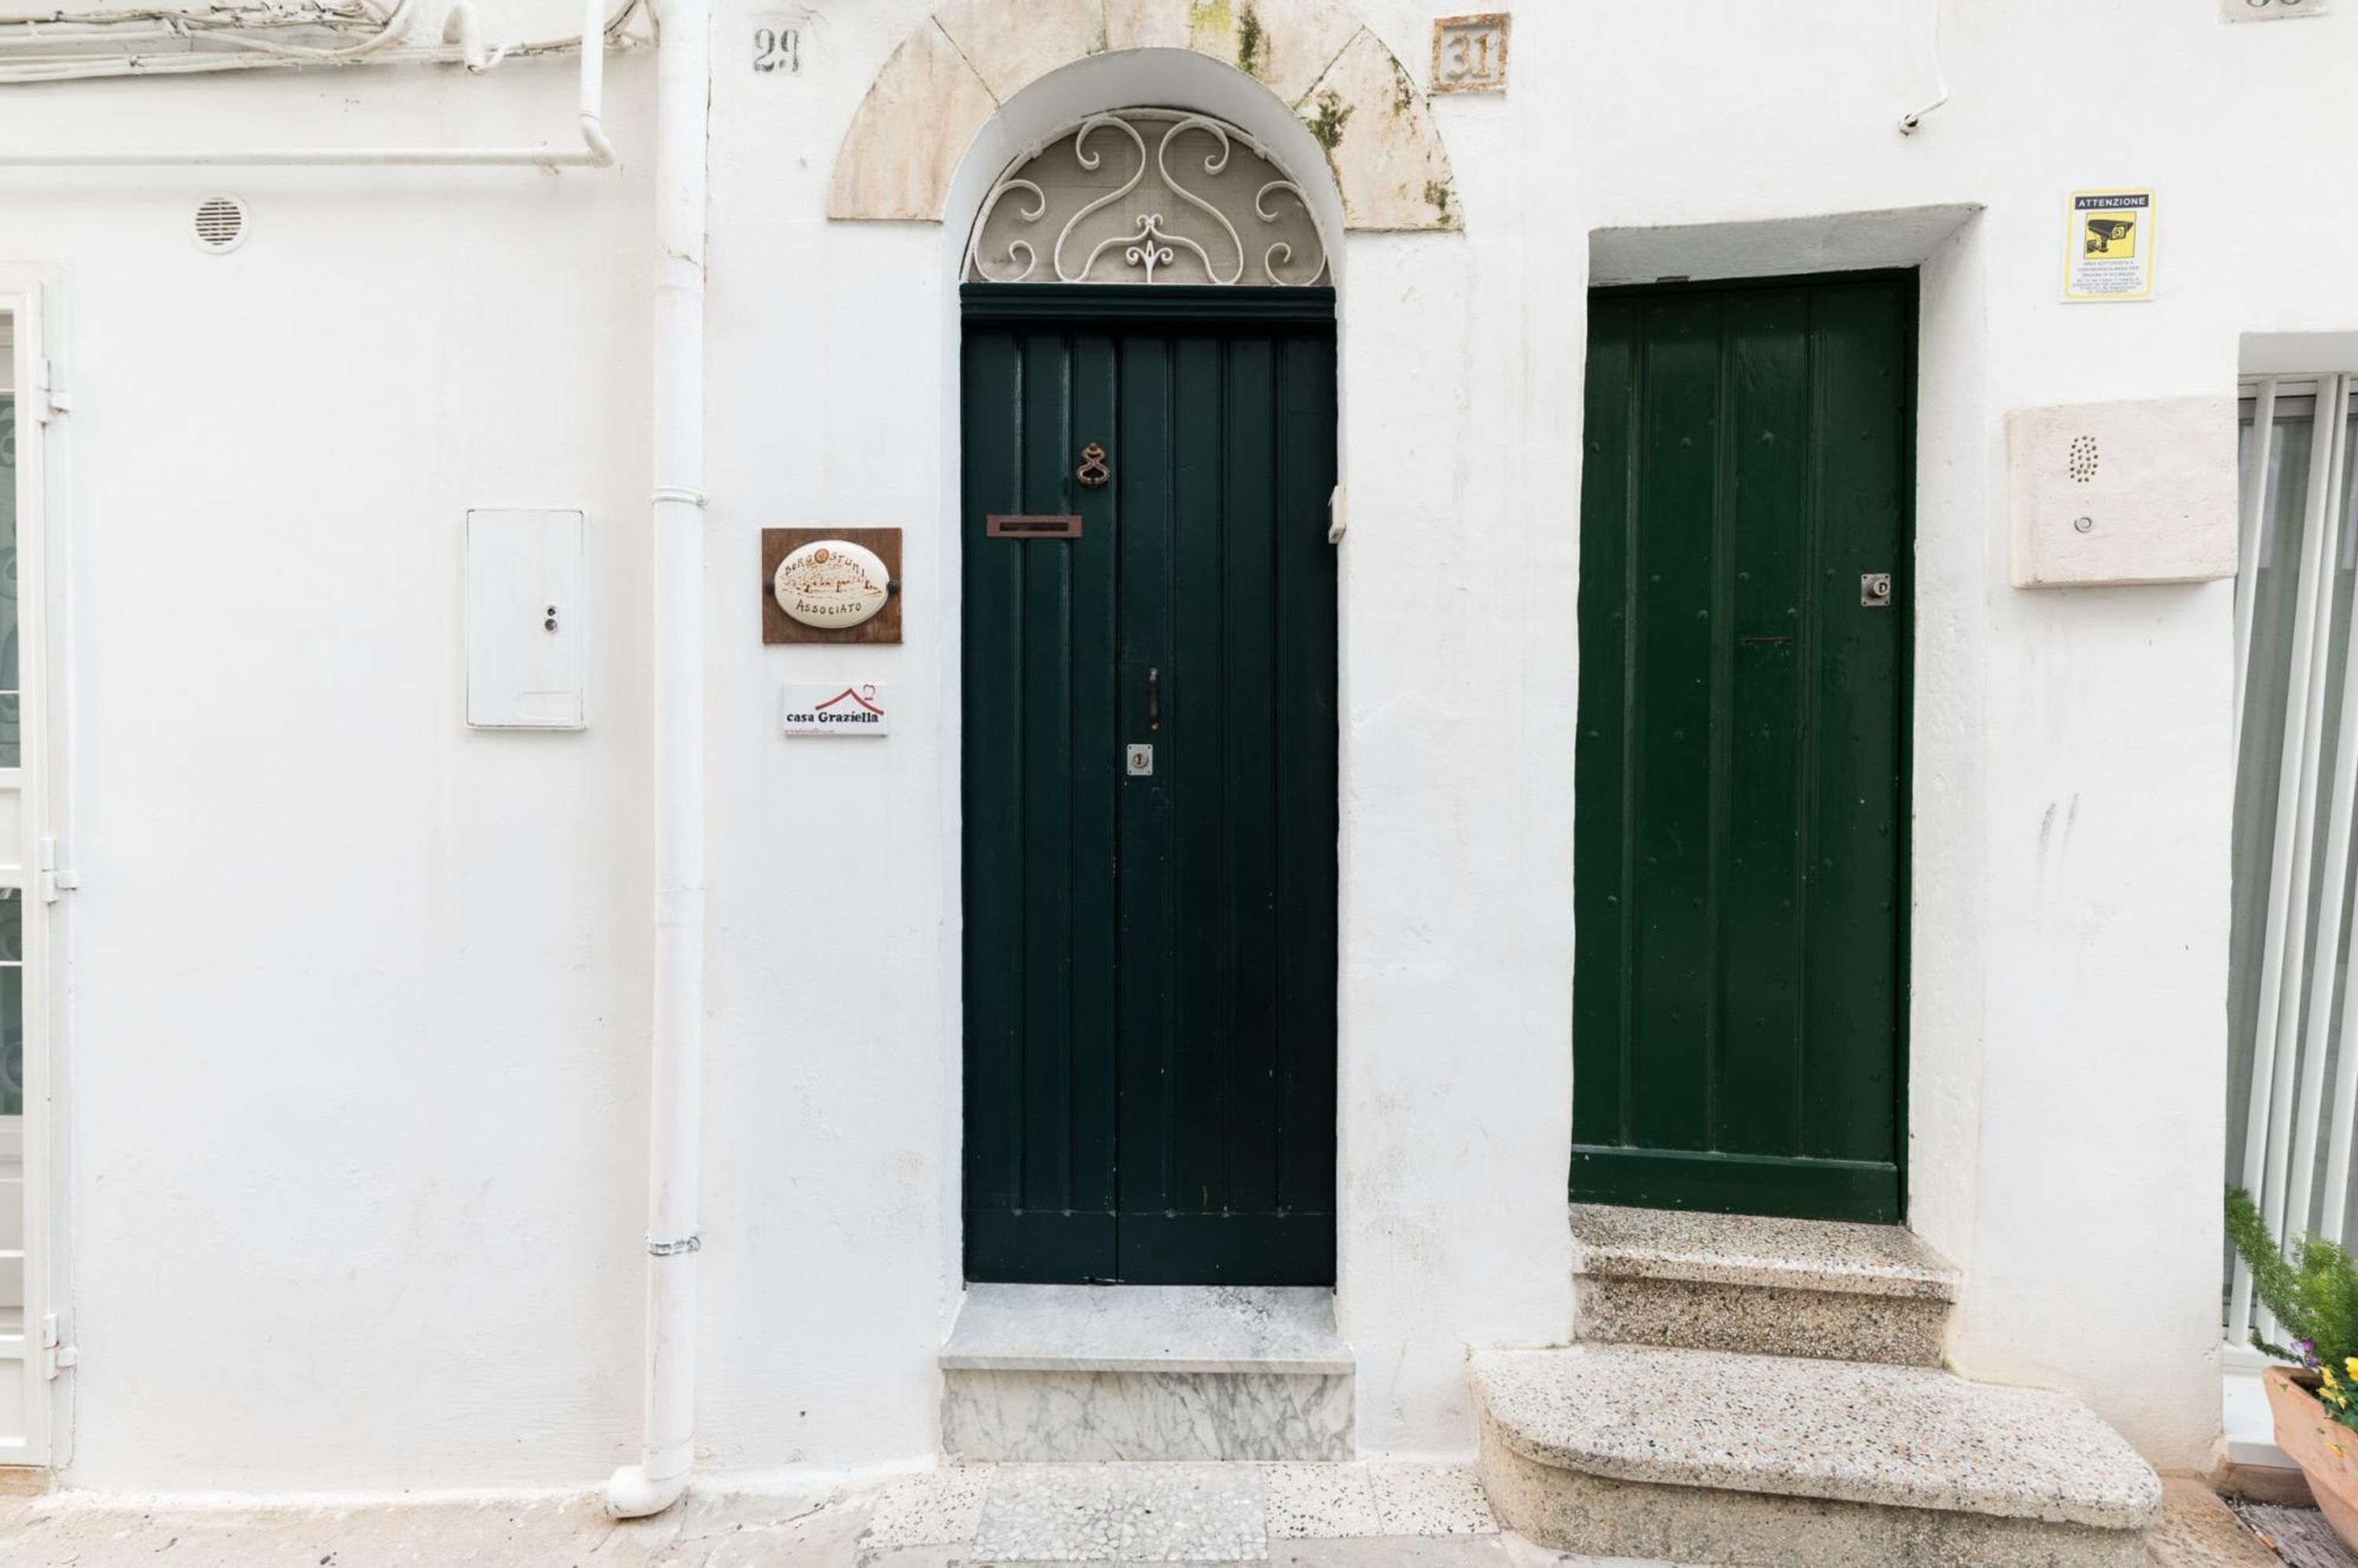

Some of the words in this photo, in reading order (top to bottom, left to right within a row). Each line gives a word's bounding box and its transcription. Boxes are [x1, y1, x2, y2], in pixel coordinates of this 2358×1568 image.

[754, 28, 799, 72] 29
[1446, 34, 1491, 80] 31
[2077, 196, 2147, 208] ATTENZIONE
[795, 598, 862, 615] ASSOCIATO
[786, 713, 814, 722] casa
[818, 711, 879, 723] Graziella
